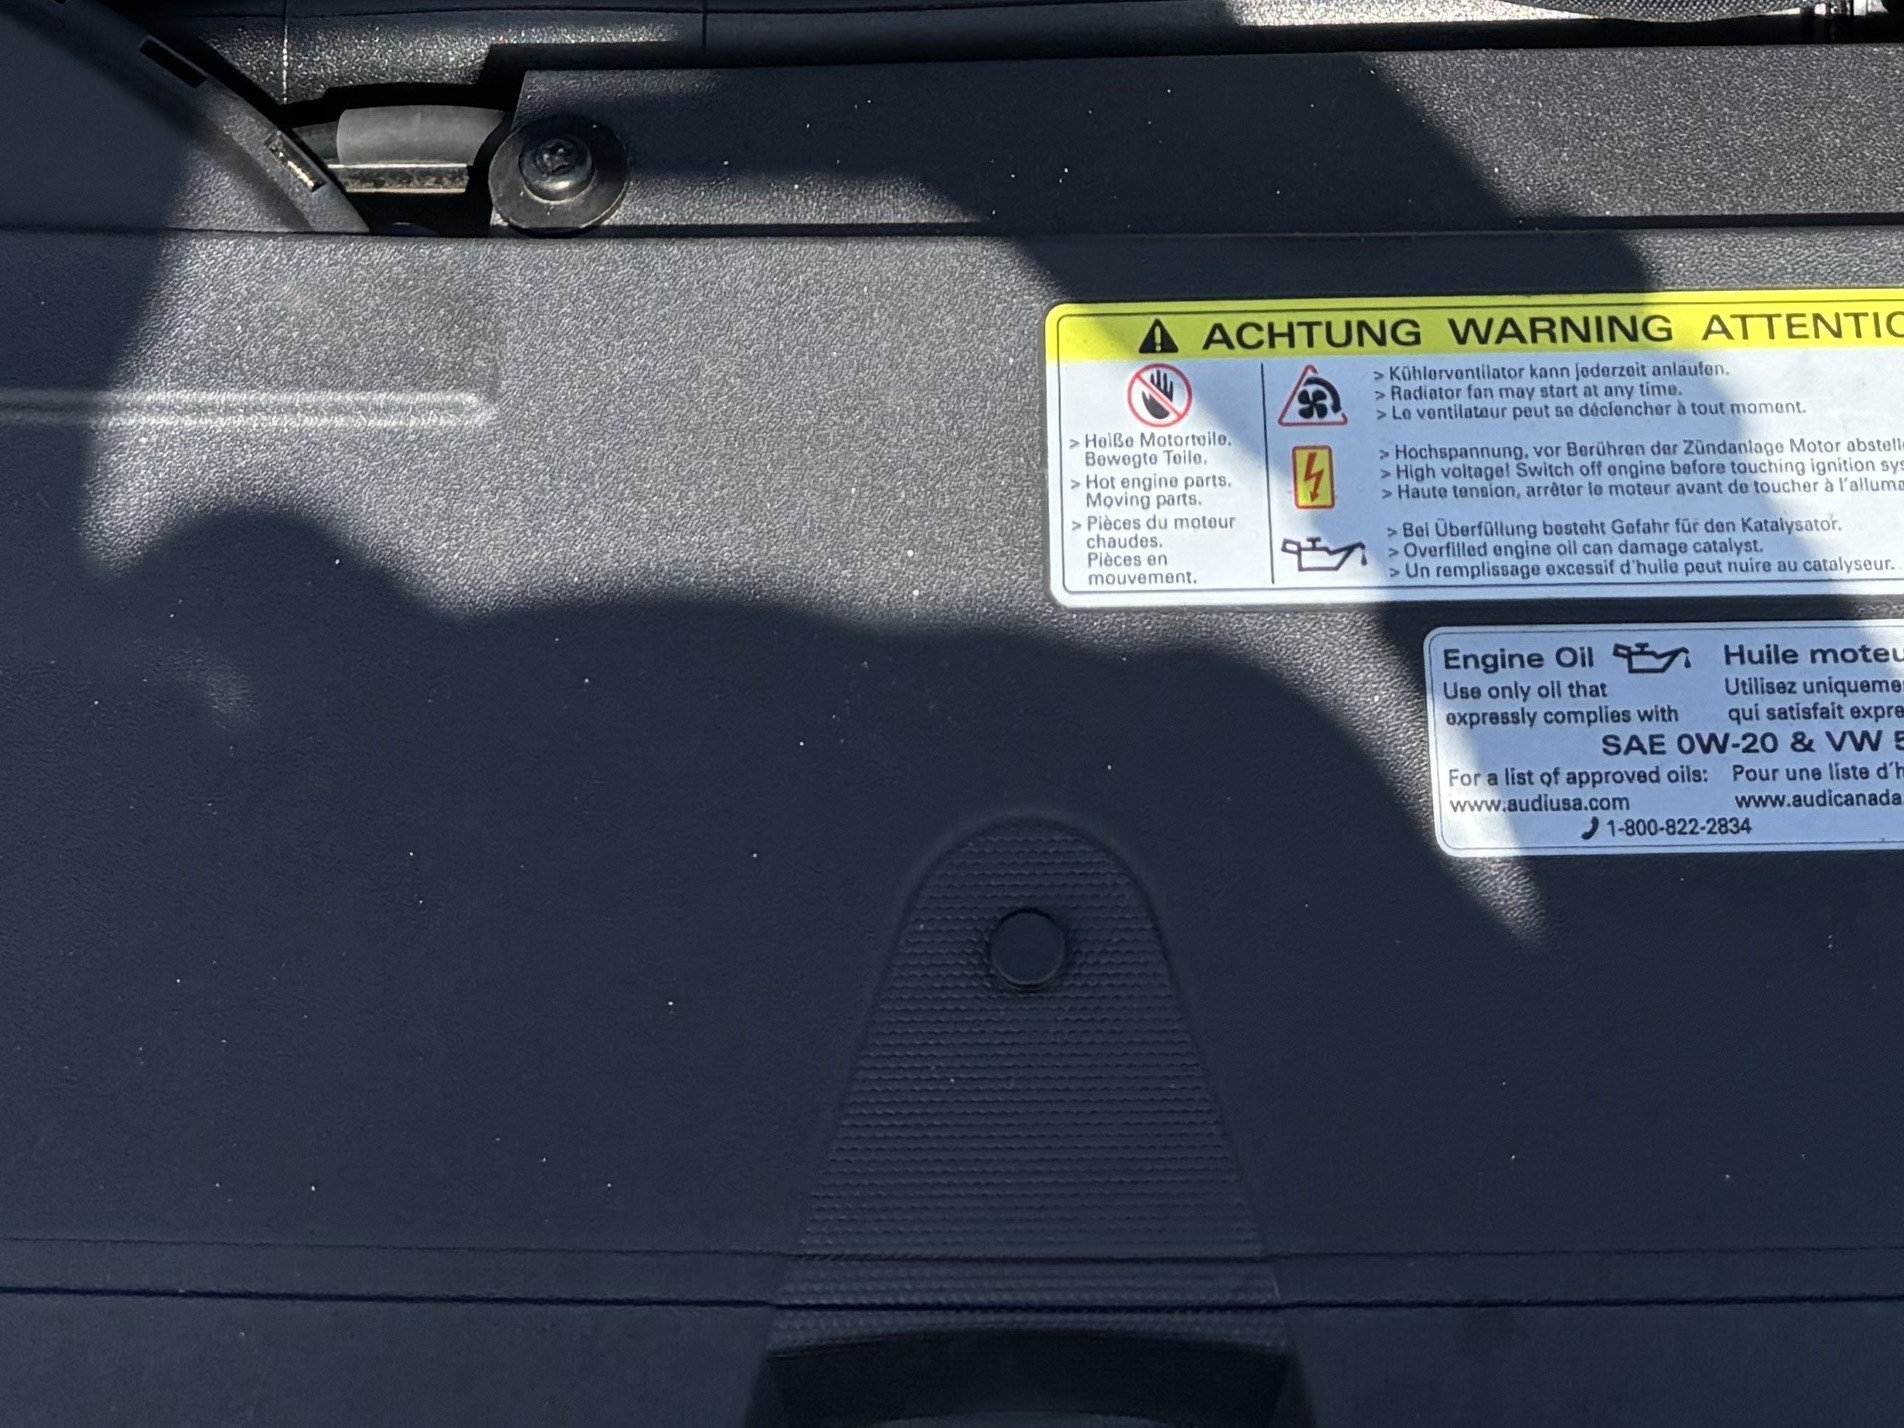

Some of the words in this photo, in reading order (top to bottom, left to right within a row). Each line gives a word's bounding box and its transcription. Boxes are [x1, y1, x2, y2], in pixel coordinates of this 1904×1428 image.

[1202, 318, 1421, 350] ACHTUNG
[1447, 314, 1672, 345] WARNING
[1389, 363, 1524, 382] Kühlerventilator
[1529, 363, 1570, 379] kann
[1575, 361, 1646, 381] jederzeit
[1651, 360, 1729, 376] anlaufen.
[1390, 384, 1461, 402] Radiator
[1467, 384, 1493, 399] fan
[1498, 387, 1535, 401] may
[1540, 383, 1578, 399] start
[1583, 384, 1598, 397] at
[1604, 385, 1634, 400] any
[1639, 380, 1681, 397] time.
[1392, 404, 1411, 420] Le
[1416, 403, 1507, 420] ventilateur
[1512, 404, 1549, 421] peut
[1555, 405, 1573, 417] se
[1578, 400, 1671, 417] déclencher
[1677, 400, 1686, 415] à
[1690, 401, 1725, 415] tout
[1729, 401, 1805, 415] moment.
[1085, 432, 1133, 448] Heiße
[1140, 431, 1231, 447] Motorteile.
[1395, 442, 1528, 464] Hochspannung,
[1532, 445, 1561, 459] vor
[1566, 440, 1645, 458] Berühren
[1650, 439, 1677, 457] der
[1682, 437, 1783, 459] Zündanlage
[1789, 437, 1840, 454] Motor
[1085, 450, 1157, 469] Bewegte
[1162, 450, 1206, 465] Teile.
[1396, 464, 1435, 484] High
[1440, 463, 1509, 483] voltage!
[1516, 462, 1574, 479] Switch
[1579, 461, 1602, 478] off
[1607, 460, 1665, 480] engine
[1670, 459, 1725, 475] before
[1730, 459, 1805, 478] touching
[1811, 457, 1875, 477] ignition
[1086, 473, 1115, 490] Hot
[1120, 473, 1178, 492] engine
[1184, 474, 1230, 490] parts.
[1397, 484, 1447, 499] Haute
[1452, 483, 1520, 500] tension,
[1526, 482, 1583, 497] arrêter
[1588, 481, 1603, 496] le
[1608, 481, 1670, 496] moteur
[1676, 480, 1723, 496] avant
[1727, 479, 1748, 494] de
[1753, 478, 1818, 494] toucher
[1824, 478, 1833, 492] à
[1086, 492, 1150, 510] Moving
[1156, 492, 1201, 509] parts.
[1087, 515, 1140, 531] Pièces
[1146, 515, 1167, 530] du
[1174, 515, 1235, 529] moteur
[1402, 521, 1429, 539] Bei
[1434, 517, 1537, 542] Überfüllung
[1542, 519, 1606, 537] besteht
[1610, 517, 1670, 536] Gefahr
[1674, 517, 1699, 533] für
[1704, 517, 1735, 535] den
[1741, 515, 1841, 536] Katalysator.
[1086, 533, 1162, 549] chaudes.
[1403, 542, 1487, 559] Overfilled
[1493, 541, 1551, 560] engine
[1556, 540, 1577, 556] oil
[1582, 543, 1613, 556] can
[1617, 538, 1688, 559] damage
[1692, 537, 1763, 557] catalyst.
[1087, 551, 1141, 568] Pièces
[1147, 555, 1167, 566] en
[1405, 563, 1430, 579] Un
[1436, 561, 1540, 581] remplissage
[1545, 560, 1614, 576] excessif
[1684, 559, 1722, 577] peut
[1727, 557, 1771, 573] nuire
[1777, 561, 1797, 572] au
[1802, 556, 1894, 574] catalyseur.
[1088, 571, 1196, 585] mouvement.
[1443, 647, 1544, 675] Engine
[1555, 646, 1594, 668] Oil
[1723, 643, 1799, 665] Huile
[1443, 681, 1481, 700] Use
[1487, 681, 1531, 702] only
[1537, 680, 1561, 699] oil
[1567, 680, 1607, 698] that
[1724, 677, 1797, 696] Utilisez
[1446, 707, 1537, 729] expressly
[1543, 706, 1631, 728] complies
[1636, 706, 1678, 723] with
[1728, 703, 1759, 725] qui
[1766, 702, 1844, 721] satisfait
[1602, 733, 1666, 756] SAE
[1677, 731, 1778, 755] 0W-20
[1790, 730, 1815, 753] &
[1825, 729, 1882, 752] VW
[1449, 768, 1481, 786] For
[1487, 772, 1498, 786] a
[1505, 767, 1534, 786] list
[1539, 767, 1560, 786] of
[1566, 765, 1660, 789] approved
[1666, 764, 1707, 783] oils:
[1732, 764, 1779, 782] Pour
[1785, 768, 1822, 781] une
[1828, 763, 1869, 780] liste
[1450, 793, 1630, 813] www.audiusa.com
[1607, 816, 1752, 837] 1-800-822-2834
